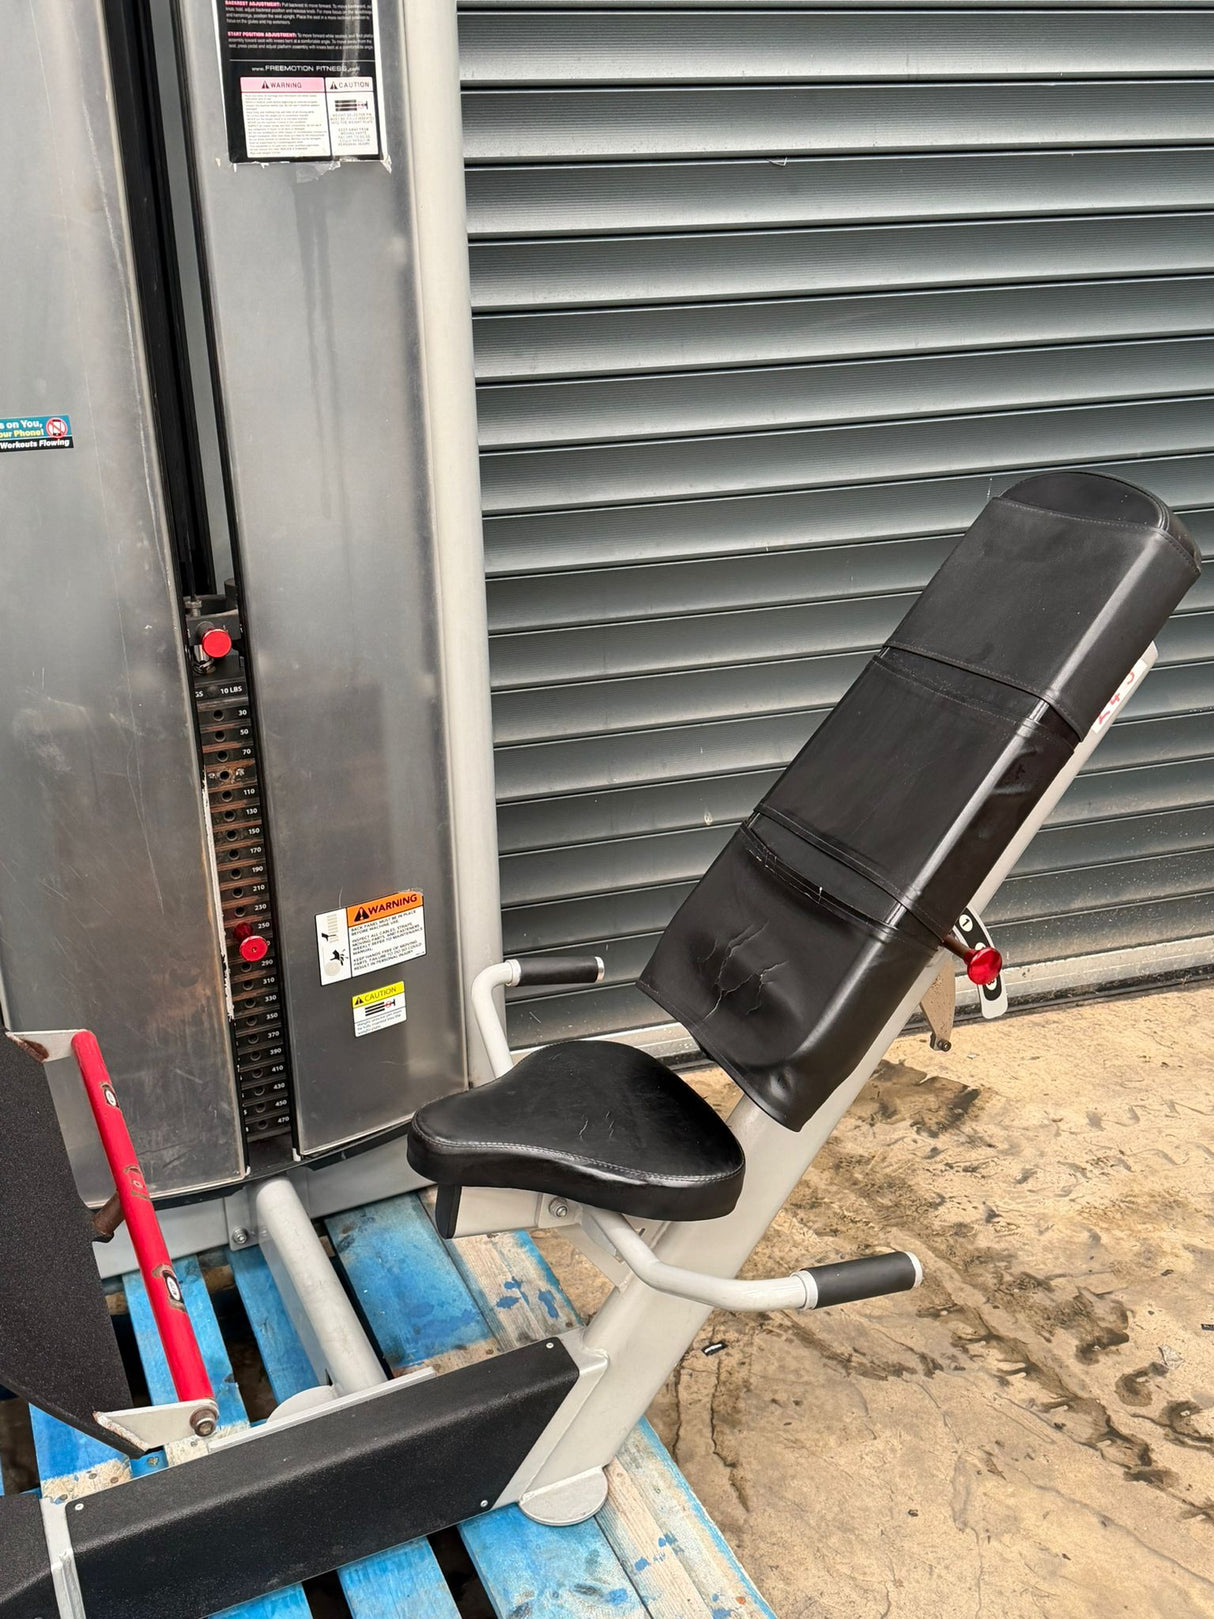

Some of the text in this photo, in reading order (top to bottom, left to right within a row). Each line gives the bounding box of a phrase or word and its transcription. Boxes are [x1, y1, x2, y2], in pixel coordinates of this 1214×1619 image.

[20, 420, 42, 428] You,
[0, 439, 70, 449] Workouts Flowing
[368, 894, 417, 915] WARNING
[962, 918, 970, 927] 1
[364, 986, 396, 1002] CAUTION
[266, 1012, 278, 1020] 350
[268, 1031, 280, 1039] 370
